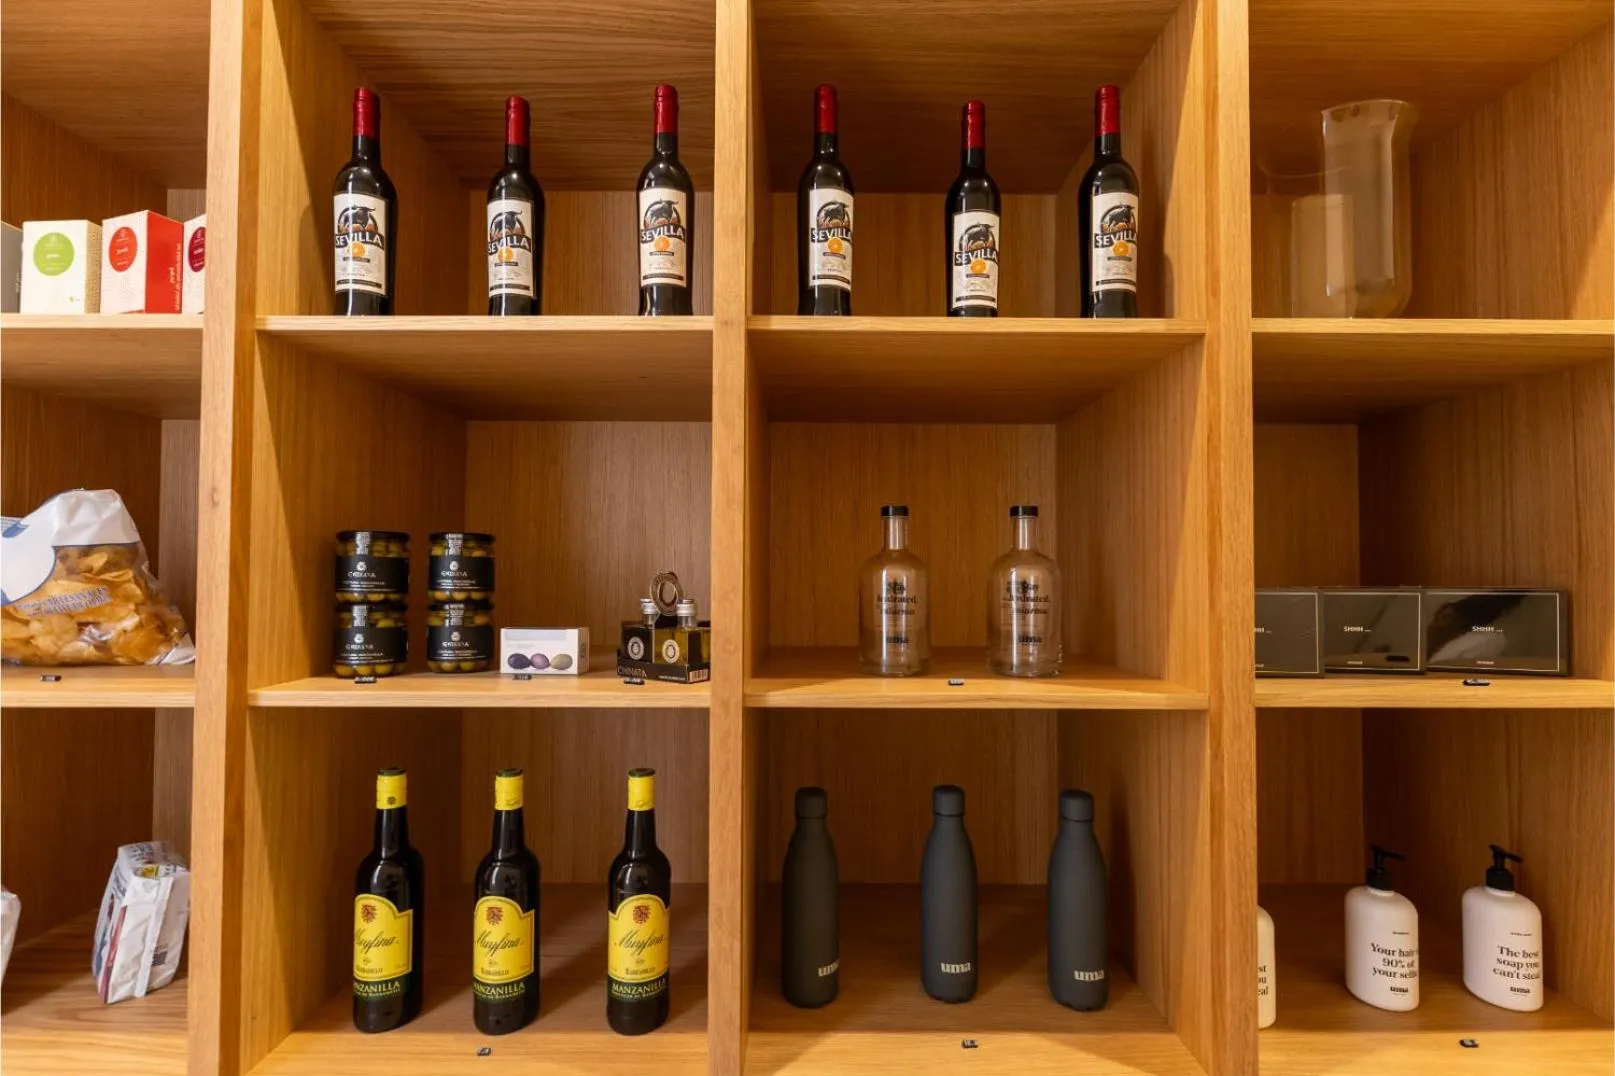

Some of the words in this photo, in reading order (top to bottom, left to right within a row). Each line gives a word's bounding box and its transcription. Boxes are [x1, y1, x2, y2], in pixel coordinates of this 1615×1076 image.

[641, 225, 684, 241] SEVILLA
[488, 236, 529, 253] SEVILLA
[955, 248, 997, 264] SEVILLA
[1370, 942, 1396, 956] Your
[1497, 945, 1521, 958] The
[940, 962, 971, 974] uma
[1496, 957, 1524, 971] soap
[1073, 970, 1104, 981] uma
[1371, 966, 1397, 979] your
